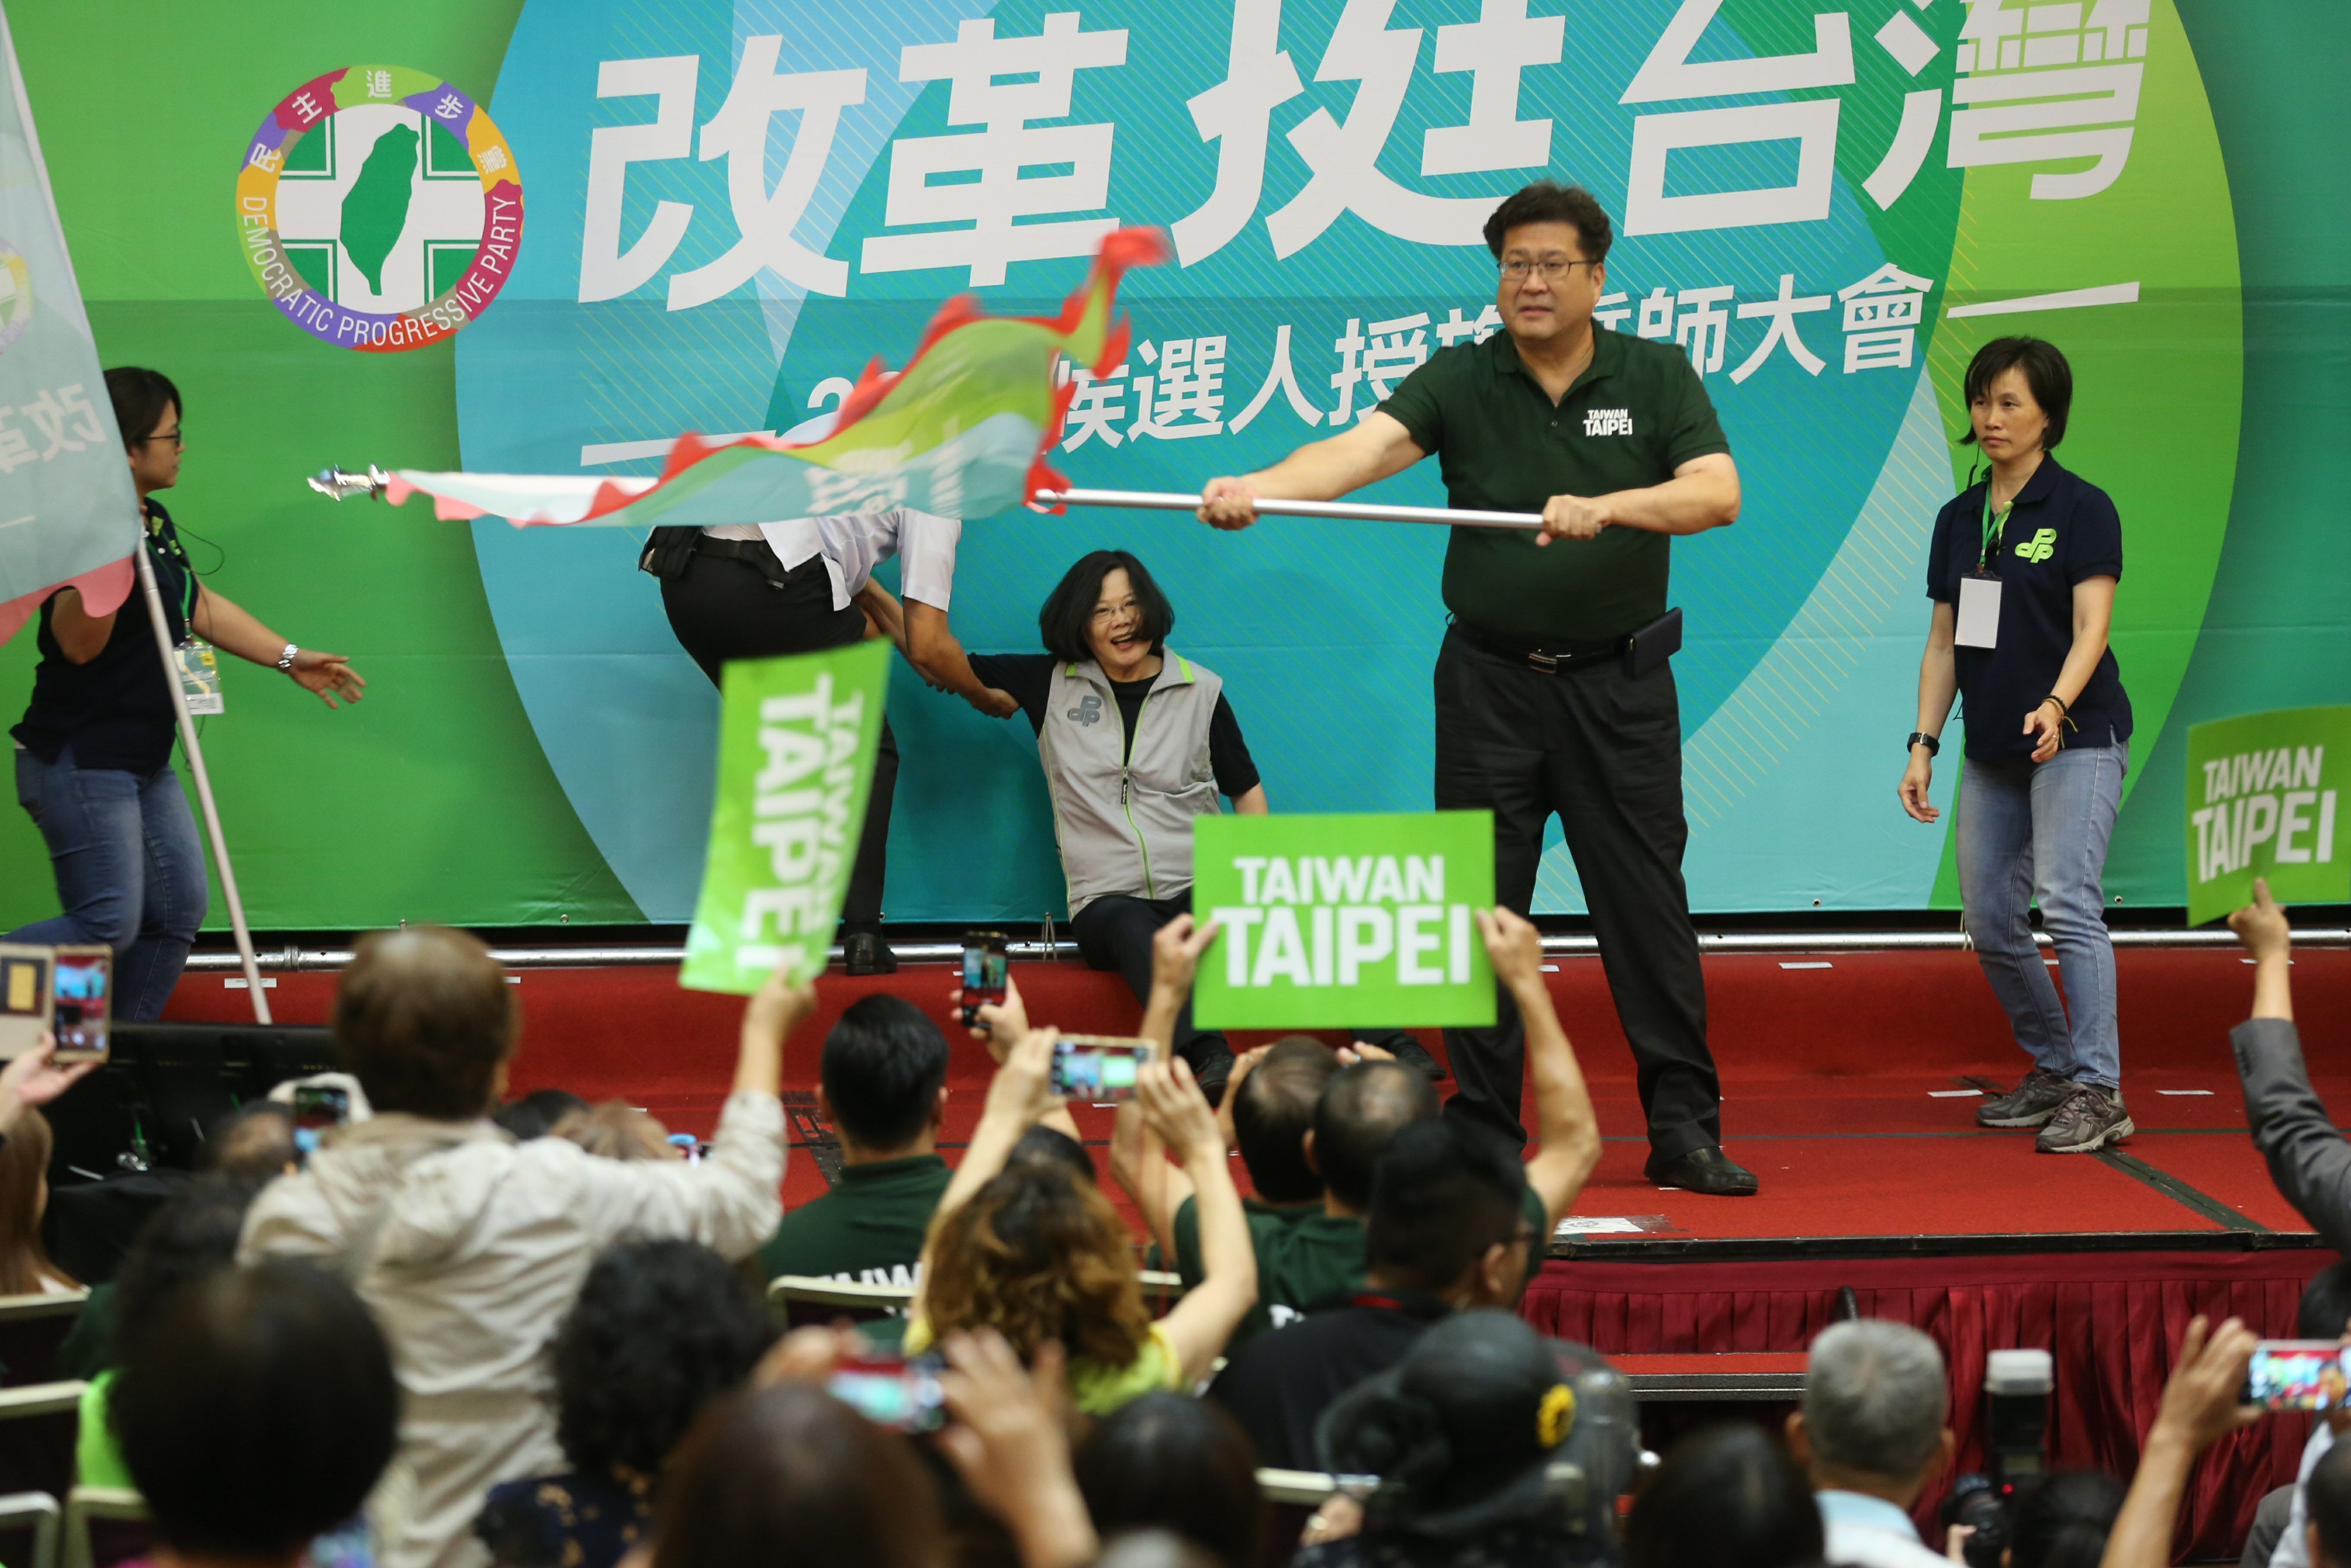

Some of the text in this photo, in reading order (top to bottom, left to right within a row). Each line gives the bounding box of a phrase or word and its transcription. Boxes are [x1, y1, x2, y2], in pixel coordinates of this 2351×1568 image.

[249, 70, 508, 174] 民主進步黨
[578, 0, 2151, 311] 改革挺台灣
[243, 196, 516, 346] DEMOCRATIC PROGRESSIVE PARTY
[1583, 418, 1633, 436] TAIPEI
[1587, 409, 1628, 419] TAIWAN
[2202, 745, 2324, 804] TAIWAN
[734, 672, 834, 970] TAIPEI
[2191, 789, 2337, 884] TAIPEI
[1233, 855, 1444, 905] TAIWAN
[1211, 903, 1470, 987] TAIPEI
